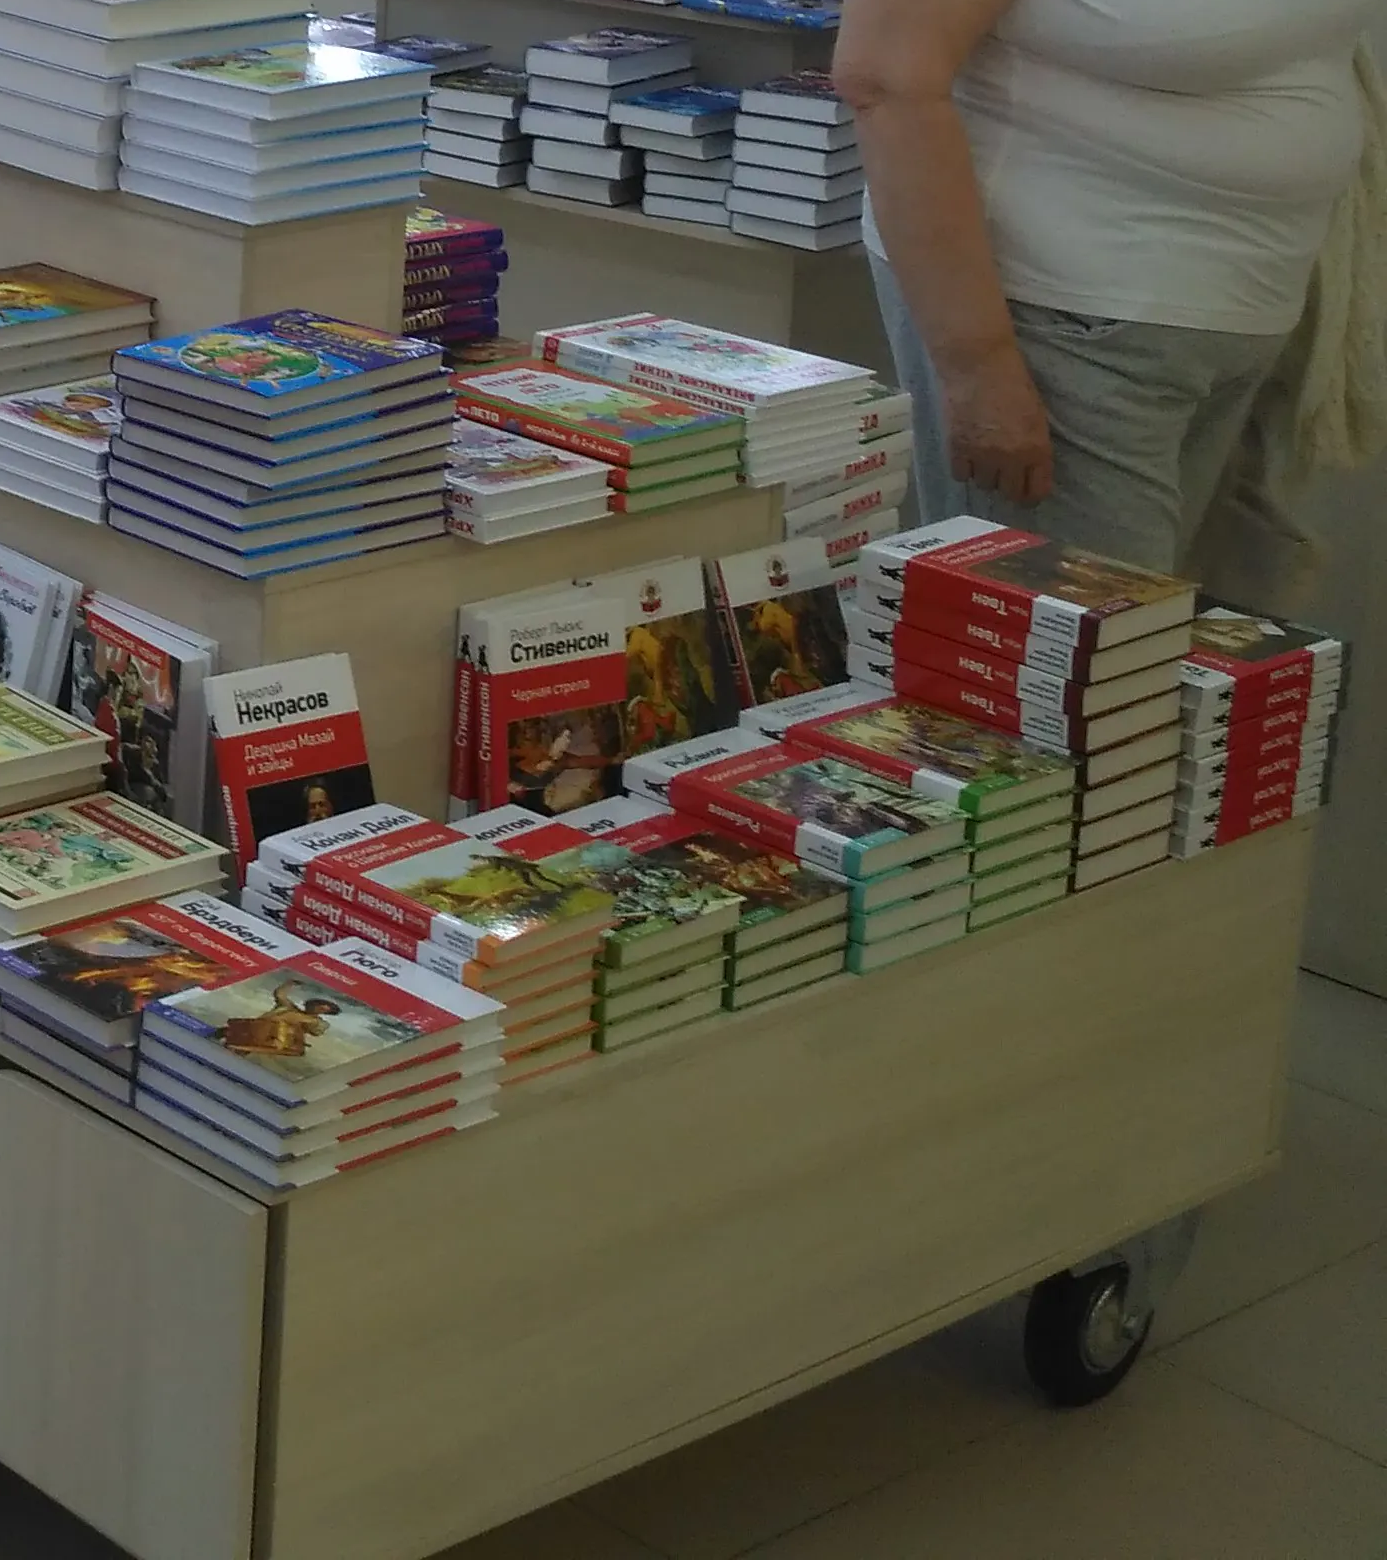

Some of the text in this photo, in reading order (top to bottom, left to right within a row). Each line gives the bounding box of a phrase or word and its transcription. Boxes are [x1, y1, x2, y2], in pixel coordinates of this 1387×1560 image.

[895, 536, 944, 553] Твен
[971, 592, 1008, 616] Твен
[510, 631, 610, 664] Стивенсон
[966, 623, 1002, 648] Твен
[958, 656, 994, 681] Твен
[233, 682, 283, 702] Николай
[455, 669, 472, 747] Стивенсон
[960, 691, 996, 716] Твен
[236, 692, 329, 725] Некрасов
[478, 681, 491, 762] Стивенсон
[244, 728, 336, 762] Дедушка Мазай
[246, 756, 295, 776] и зайцы
[301, 813, 416, 852] Конан Дойл
[314, 871, 356, 903] Дойл
[302, 894, 344, 926] Дойл
[357, 891, 405, 925] Конан
[179, 902, 279, 951] Брэдбери
[344, 913, 392, 949] Конан
[339, 948, 400, 980] Гюго
